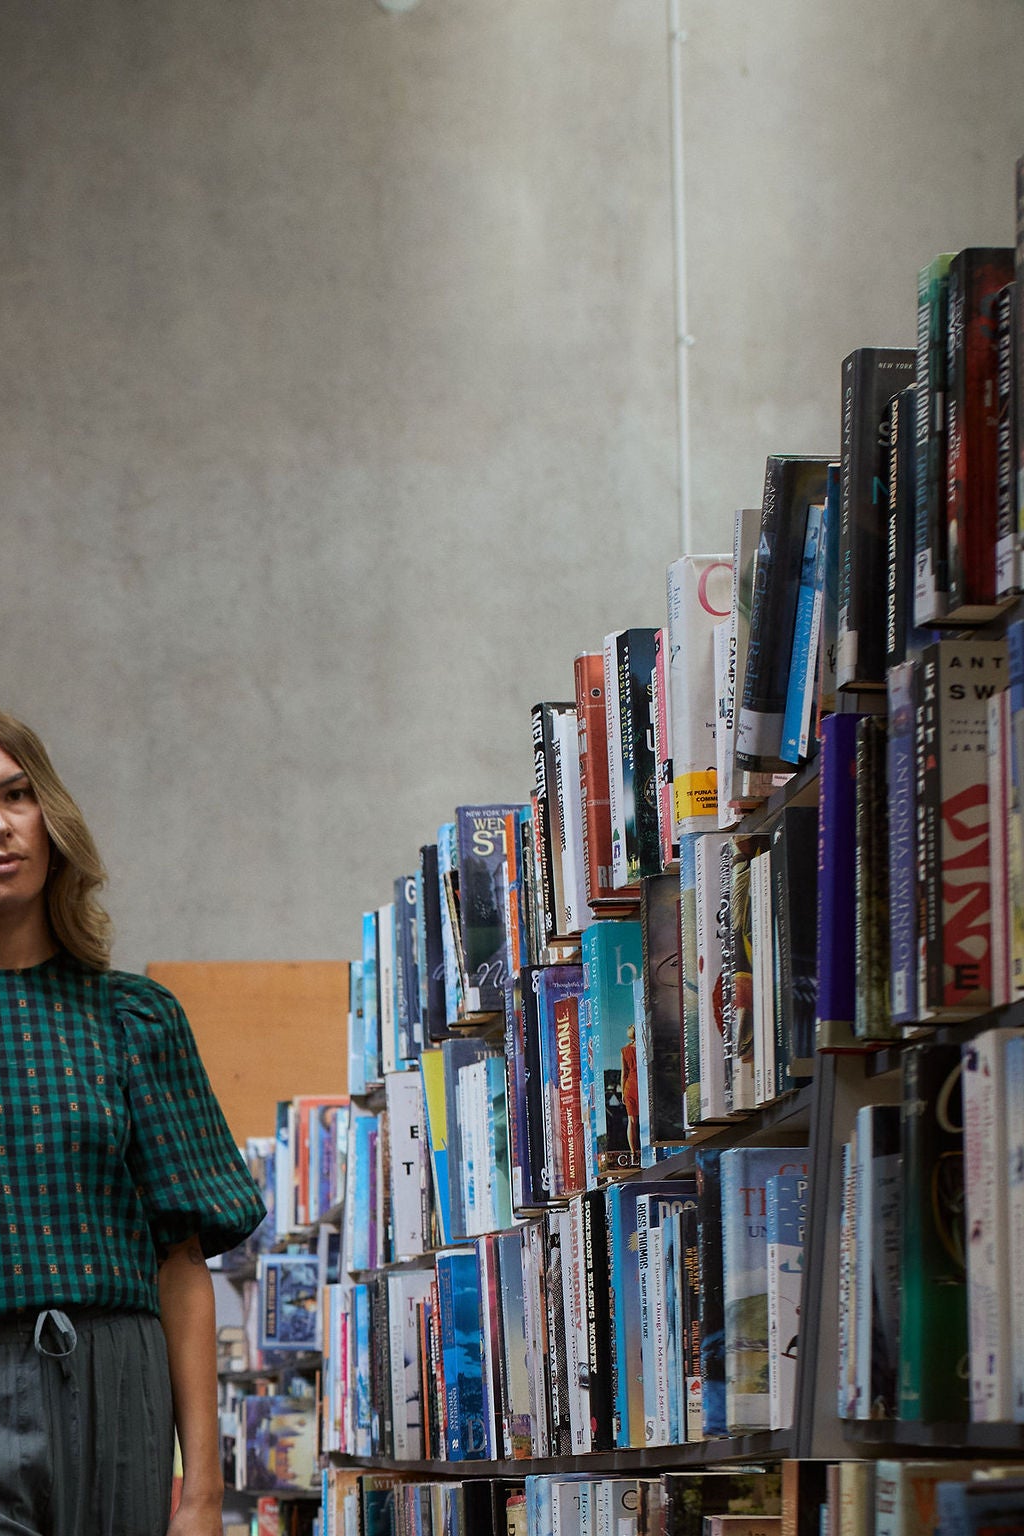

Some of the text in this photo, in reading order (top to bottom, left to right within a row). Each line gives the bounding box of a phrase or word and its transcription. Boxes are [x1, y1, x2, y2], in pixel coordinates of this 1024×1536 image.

[892, 362, 914, 370] YORK
[915, 303, 930, 448] INFORMATIONIST
[889, 399, 899, 445] DAVID
[948, 400, 957, 504] INNOCENT
[842, 387, 853, 535] CHEVY STEVENS
[761, 471, 772, 526] STEVENS
[767, 486, 776, 514] ANN
[888, 513, 897, 560] WHITE
[673, 586, 681, 621] Julia
[750, 568, 767, 630] Close
[844, 550, 852, 607] NEVER
[887, 564, 897, 591] FOR
[887, 593, 896, 654] DANGER
[604, 645, 615, 739] Homecoming
[623, 646, 634, 770] PERSONS UNKNOWN
[725, 637, 736, 730] CAMP ZERO
[924, 662, 936, 744] EXIT
[531, 711, 547, 799] MEL STEIN
[621, 707, 629, 759] STEINER
[555, 760, 563, 792] WHITE
[896, 752, 911, 856] ANTONIA
[558, 794, 567, 853] CORRIDORS
[540, 835, 548, 879] Against
[696, 842, 704, 903] GRAHAM
[505, 987, 514, 1059] JAMES SWAIN
[589, 937, 601, 1054] before you go
[579, 998, 590, 1061] WITHOUT
[557, 1021, 576, 1179] NOMAD JAMES SWALLOW
[637, 1203, 646, 1228] ROSS
[570, 1204, 582, 1331] HARD MONEY
[638, 1230, 648, 1270] THOMAS
[585, 1200, 597, 1374] SOMEONE ELSE'S MONEY
[656, 1300, 664, 1331] Things
[657, 1333, 663, 1343] to
[550, 1342, 558, 1424] DARKEST
[658, 1394, 666, 1422] Mend
[580, 1492, 589, 1525] How
